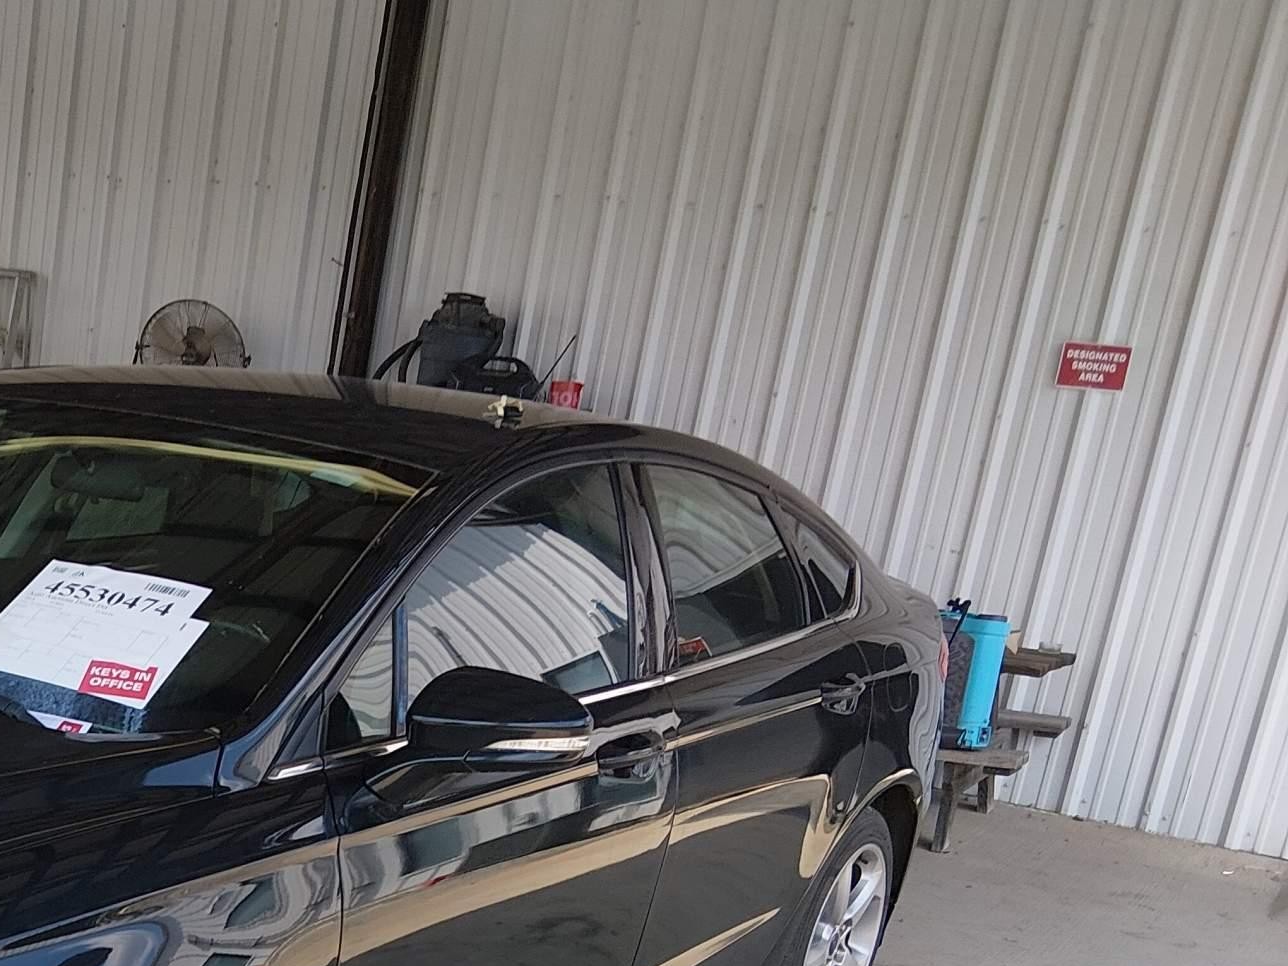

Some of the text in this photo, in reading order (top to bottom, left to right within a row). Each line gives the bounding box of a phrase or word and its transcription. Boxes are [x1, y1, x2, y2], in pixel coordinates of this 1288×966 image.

[1066, 348, 1127, 363] DESIGNATED
[1071, 360, 1117, 373] SMOKING
[1078, 371, 1104, 383] AREA
[44, 580, 175, 617] 45530474
[90, 666, 152, 682] KEYS IN
[89, 677, 144, 692] OFFICE
